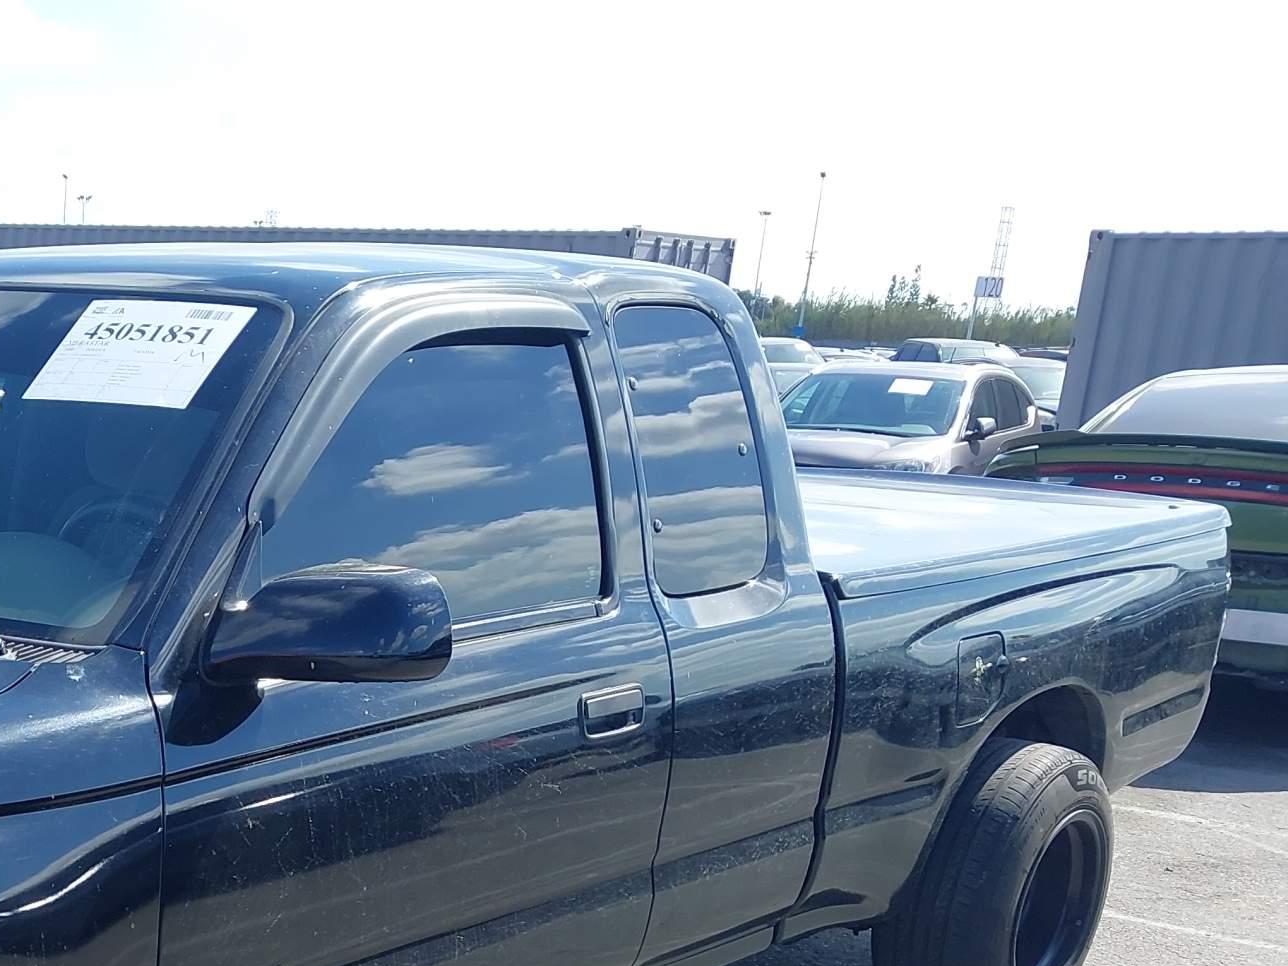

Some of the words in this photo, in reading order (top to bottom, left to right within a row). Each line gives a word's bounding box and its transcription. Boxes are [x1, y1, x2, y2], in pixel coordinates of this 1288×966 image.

[984, 277, 1004, 298] 120
[84, 322, 215, 346] 45051851
[1114, 473, 1281, 492] DODGE
